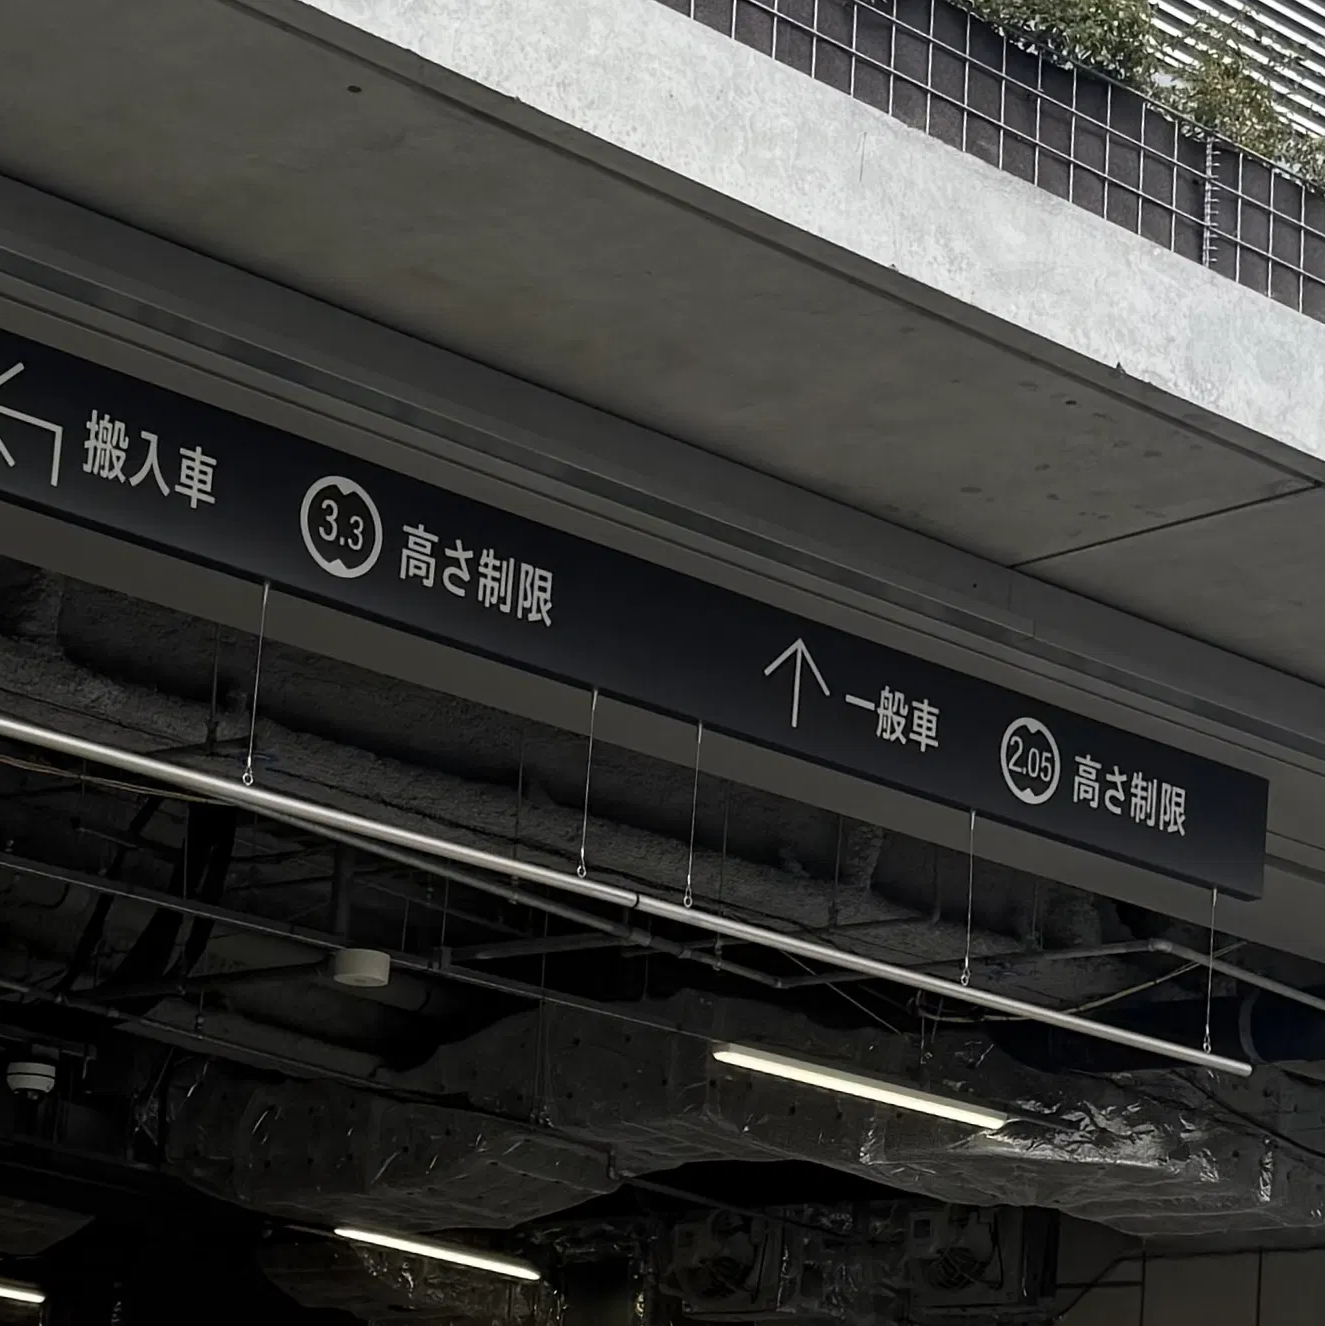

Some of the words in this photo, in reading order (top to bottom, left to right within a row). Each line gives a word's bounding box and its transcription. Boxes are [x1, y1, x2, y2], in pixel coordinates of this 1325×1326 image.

[82, 409, 217, 509] 搬入車
[317, 498, 366, 554] 3.3
[399, 524, 554, 627] 高さ制限
[845, 685, 940, 753] 一般車
[1008, 736, 1053, 780] 2.05
[1073, 754, 1187, 837] 高さ制限
